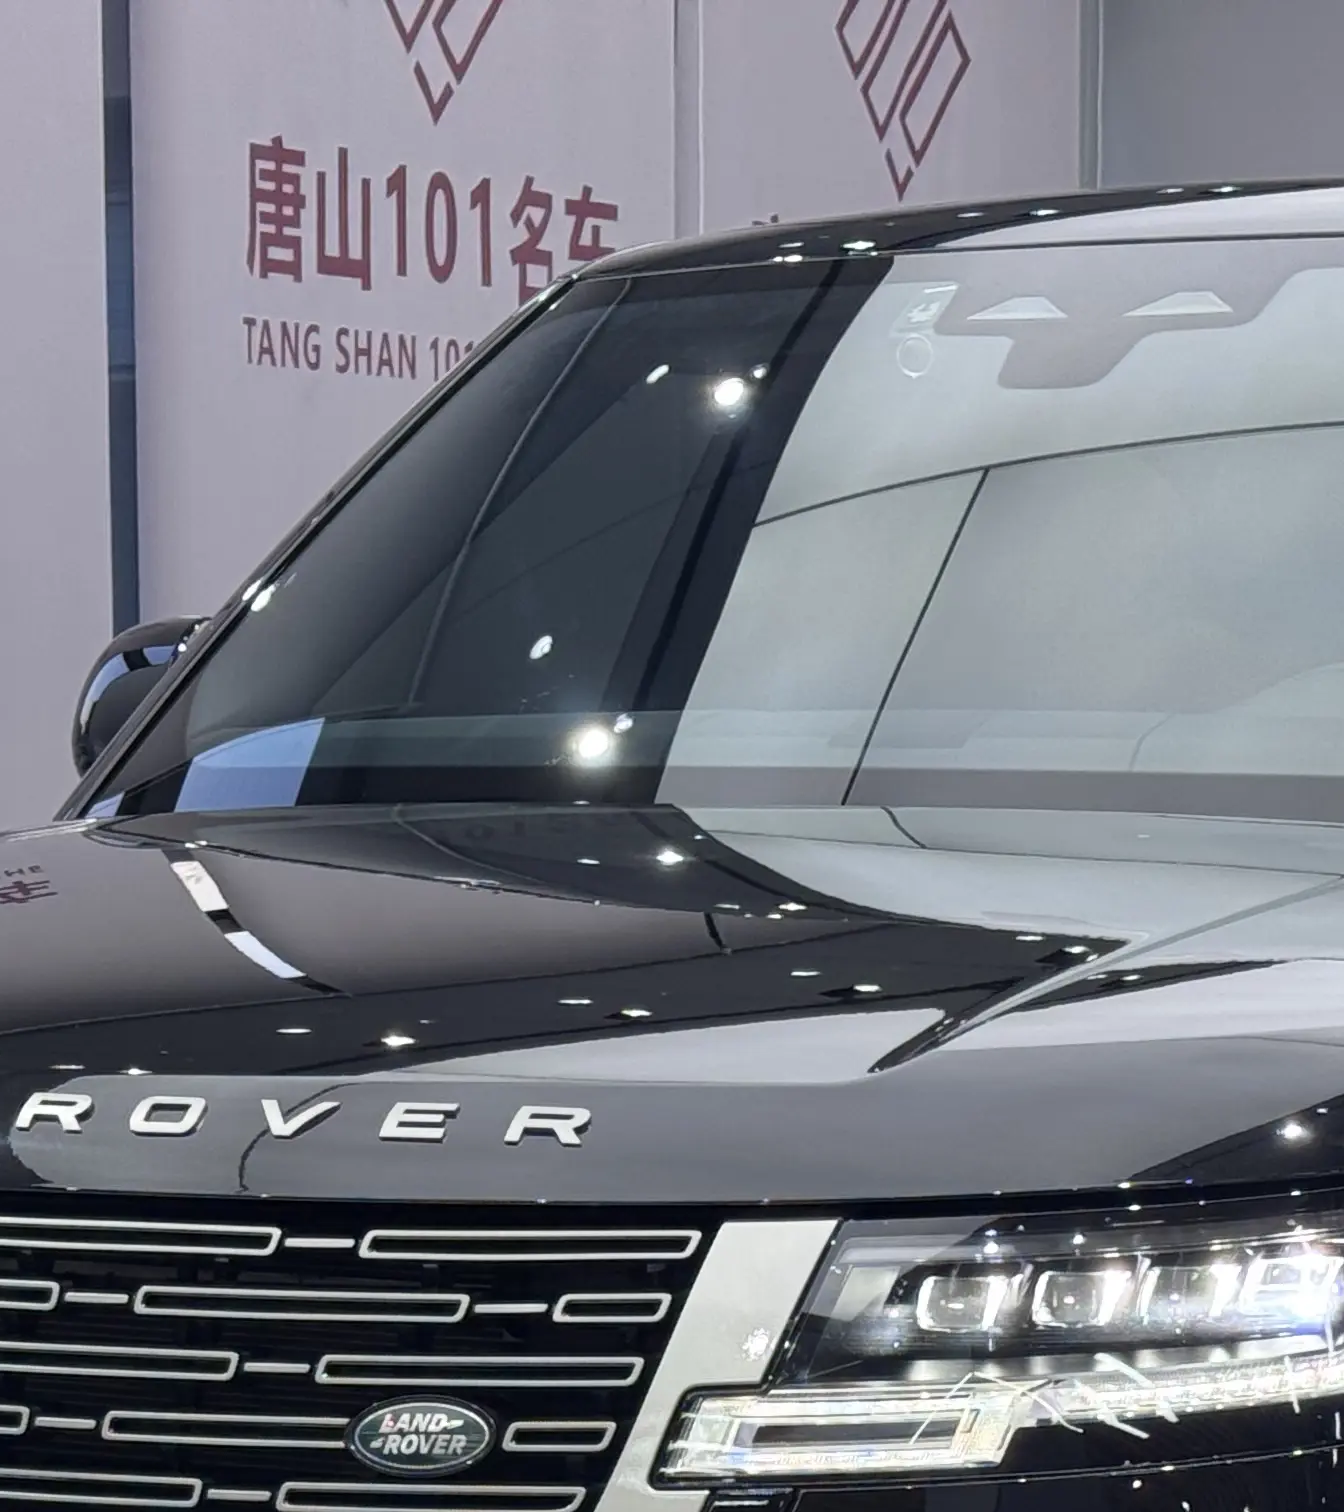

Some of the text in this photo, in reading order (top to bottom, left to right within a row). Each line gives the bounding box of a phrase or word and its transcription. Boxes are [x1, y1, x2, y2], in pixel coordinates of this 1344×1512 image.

[242, 316, 321, 370] TANG
[335, 327, 417, 380] SHAN
[15, 1092, 592, 1146] ROVER
[381, 1434, 468, 1455] ROVER
